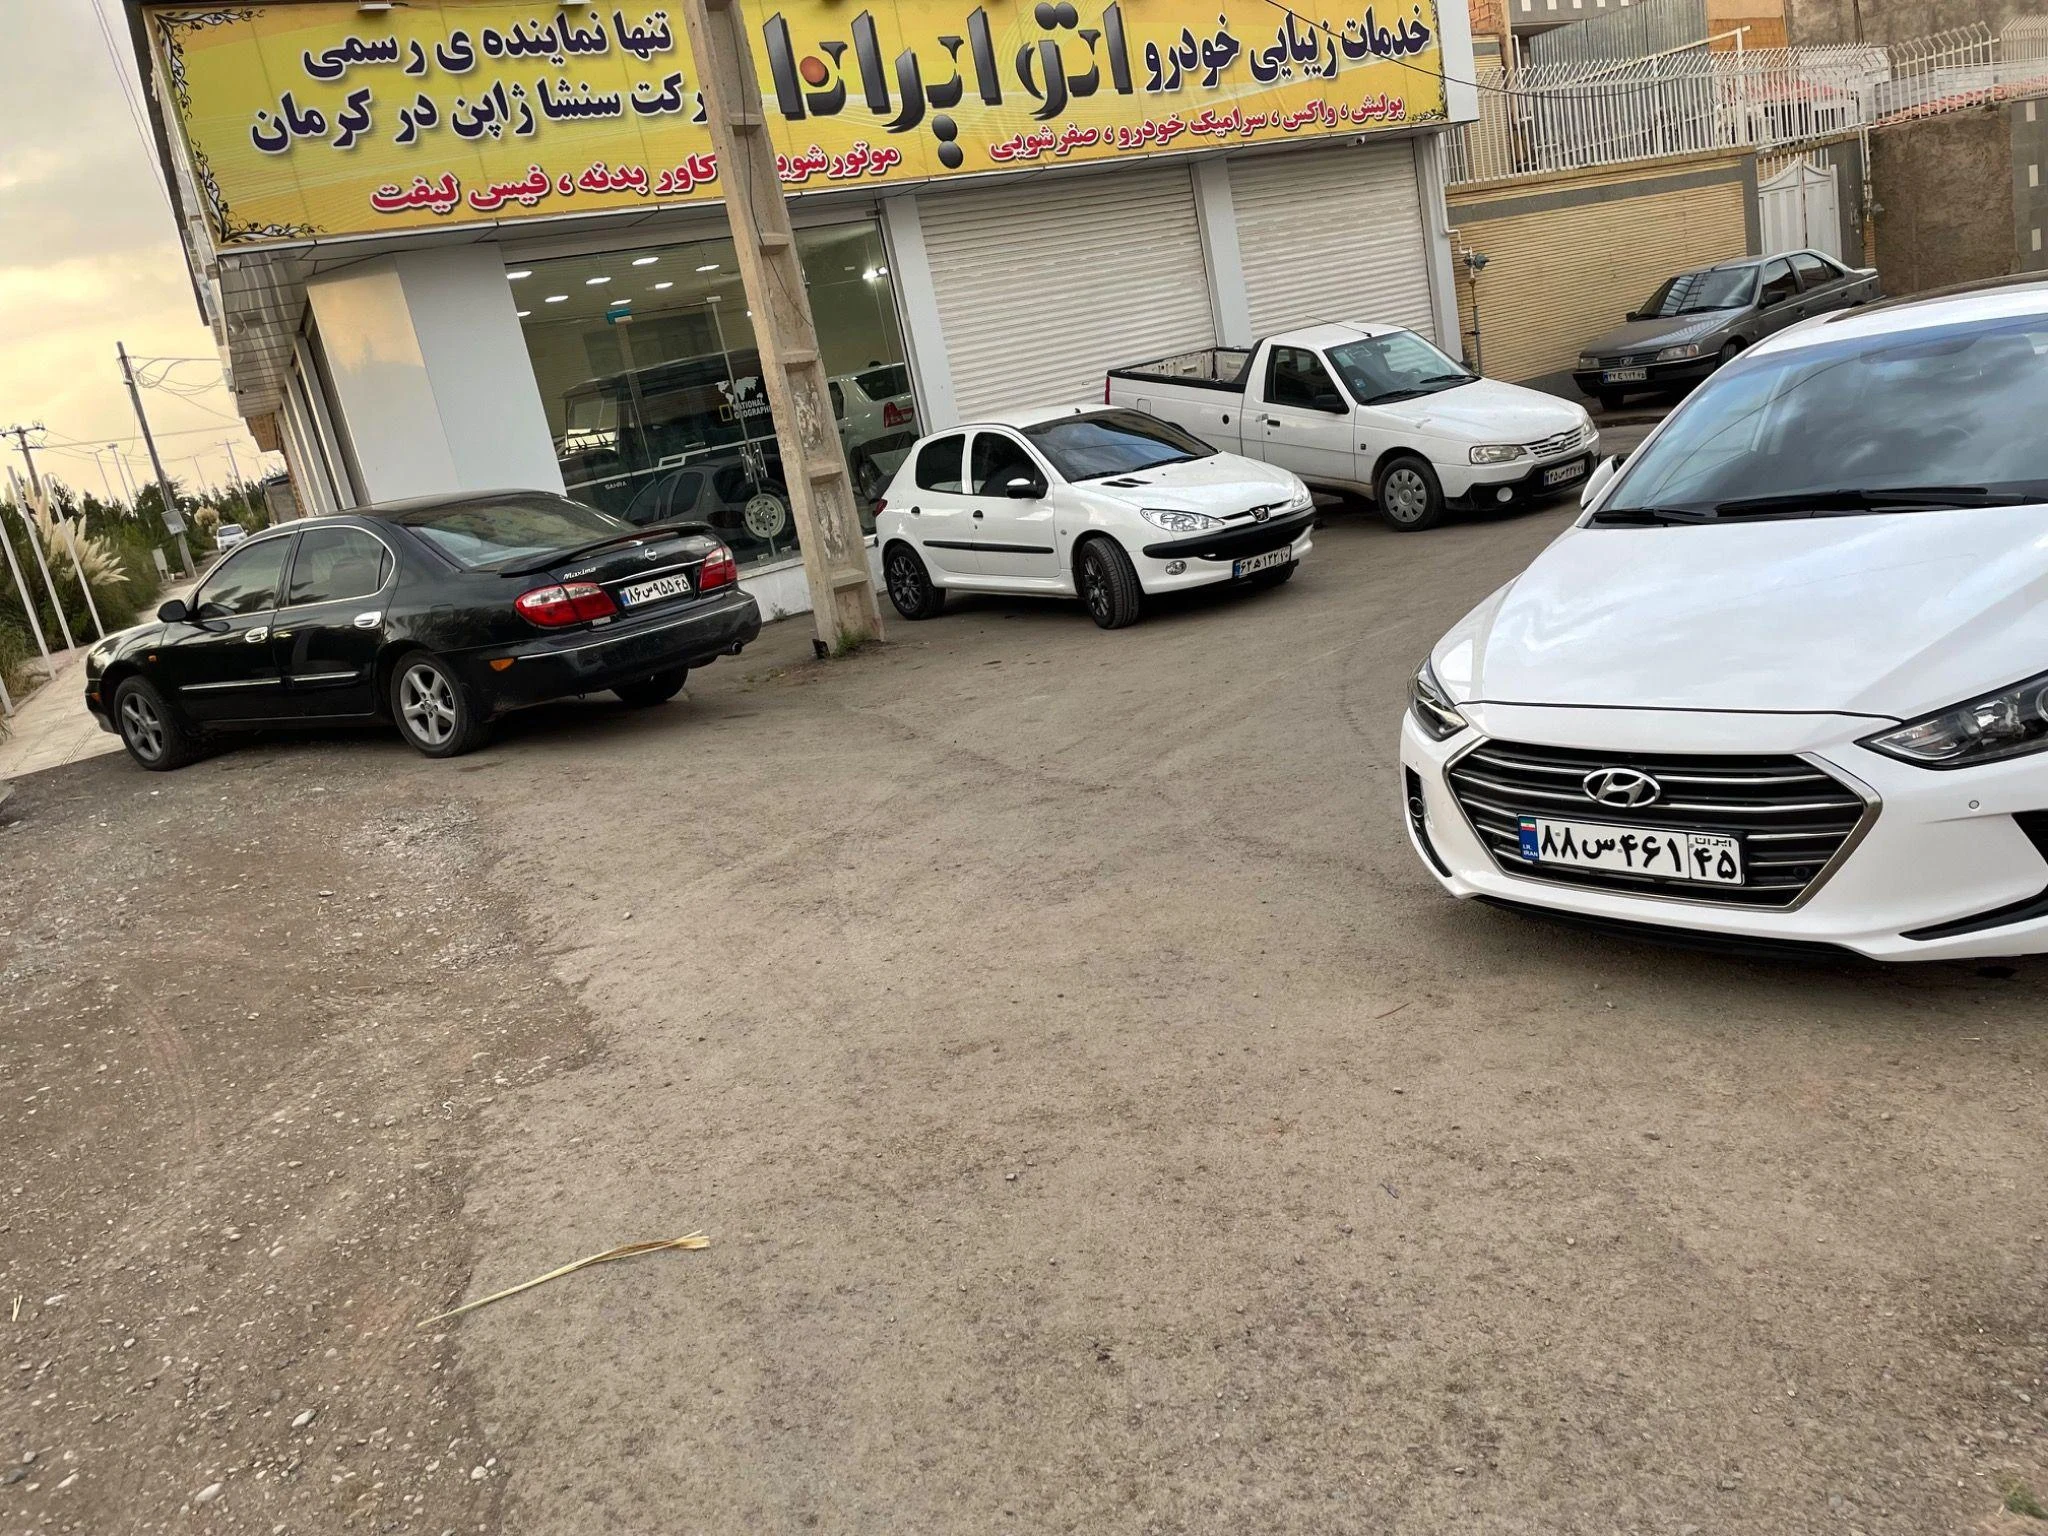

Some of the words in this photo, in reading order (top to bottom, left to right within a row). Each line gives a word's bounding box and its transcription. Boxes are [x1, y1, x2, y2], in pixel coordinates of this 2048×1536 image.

[482, 11, 608, 65] نماینده
[613, 10, 672, 60] تنها
[1145, 13, 1241, 92] خودرو
[1249, 9, 1338, 84] زیبایی
[1340, 4, 1431, 60] خدمات
[303, 35, 426, 79] رسمی
[251, 87, 372, 153] کرمان
[394, 94, 438, 143] در
[451, 79, 534, 138] ژاپن
[536, 77, 622, 119] سنشا
[631, 72, 708, 124] رکت
[1282, 100, 1337, 132] واکس
[1350, 94, 1404, 126] پولیش
[1117, 113, 1185, 148] خودرو
[1189, 109, 1267, 137] سرامیک
[371, 173, 458, 213] لیفت
[469, 164, 549, 208] فیس
[578, 164, 648, 194] بدنه
[653, 153, 717, 195] کاور
[563, 566, 597, 580] Maxima
